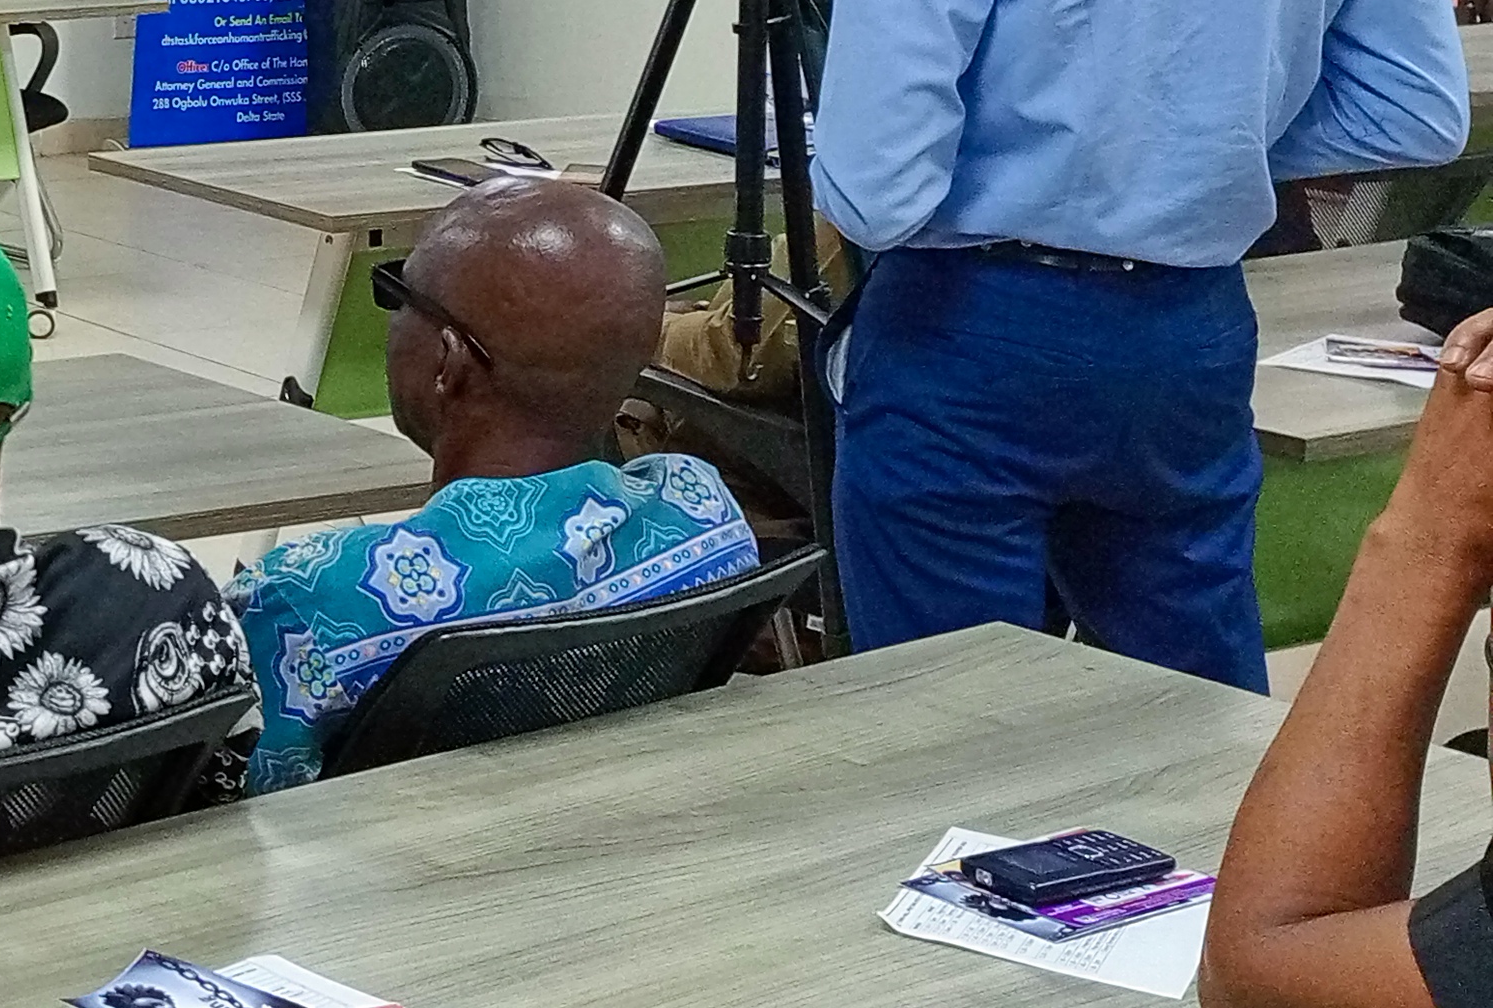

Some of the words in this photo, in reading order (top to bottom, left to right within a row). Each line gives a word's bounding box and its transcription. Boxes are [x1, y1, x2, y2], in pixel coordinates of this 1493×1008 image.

[214, 16, 227, 28] Or
[229, 14, 253, 27] Send
[255, 14, 267, 26] An
[232, 58, 259, 72] Office
[261, 56, 271, 70] of
[272, 56, 287, 68] The
[155, 80, 195, 94] Attorney
[197, 77, 235, 90] General
[237, 76, 254, 88] and
[237, 110, 261, 123] Delta
[263, 110, 285, 122] State
